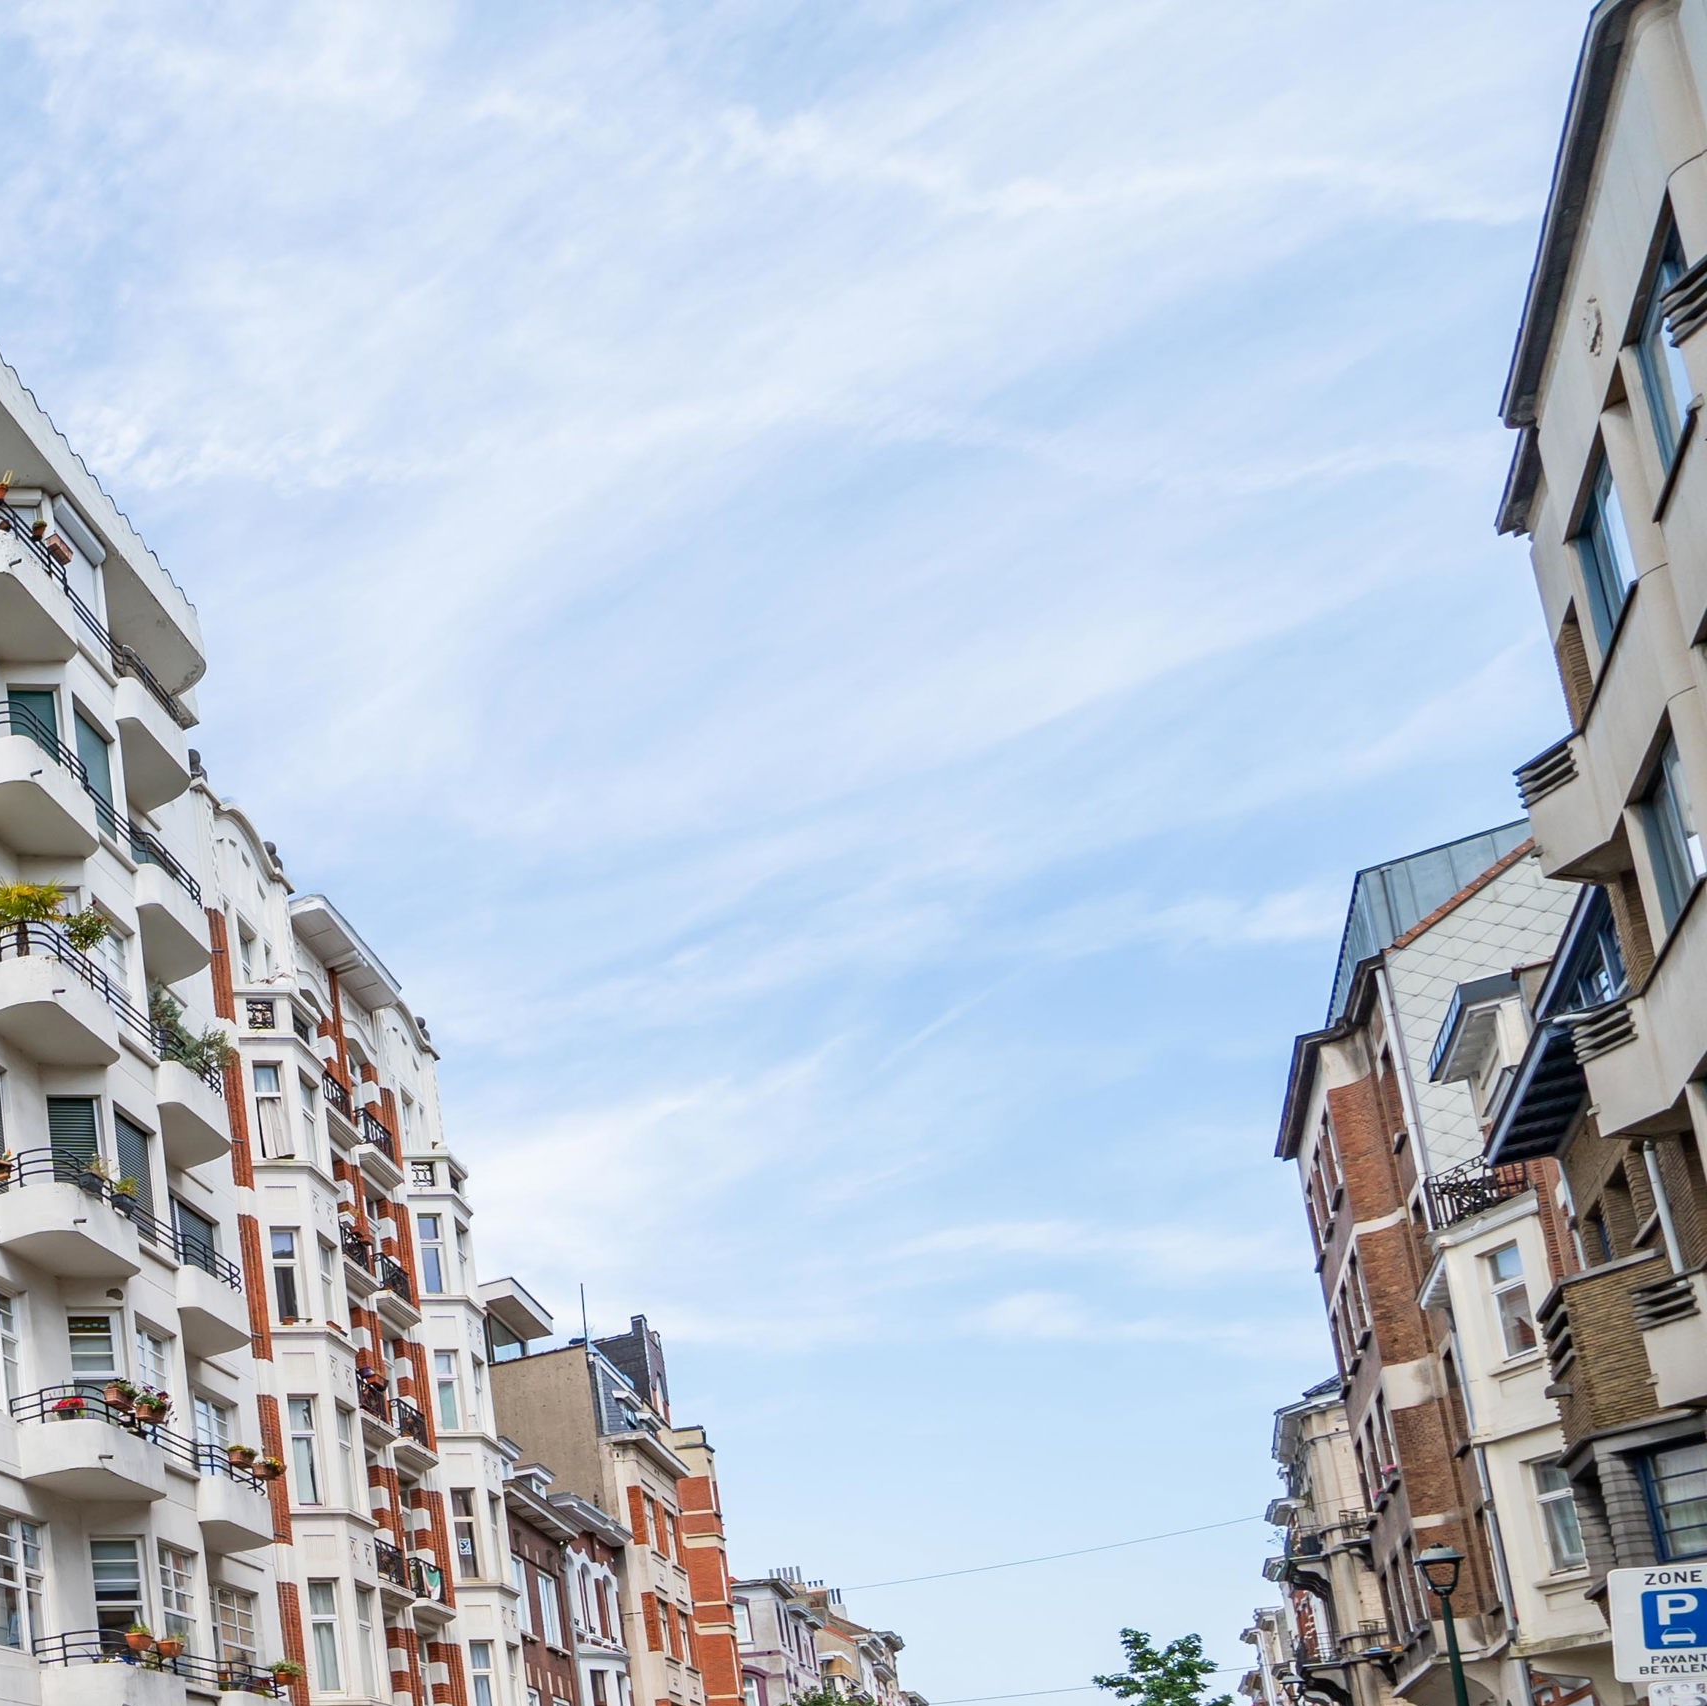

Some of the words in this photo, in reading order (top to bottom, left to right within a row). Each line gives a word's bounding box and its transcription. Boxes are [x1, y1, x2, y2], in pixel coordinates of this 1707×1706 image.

[1644, 1570, 1703, 1586] ZONE
[1656, 1593, 1698, 1626] P
[1651, 1653, 1707, 1665] PAYANT
